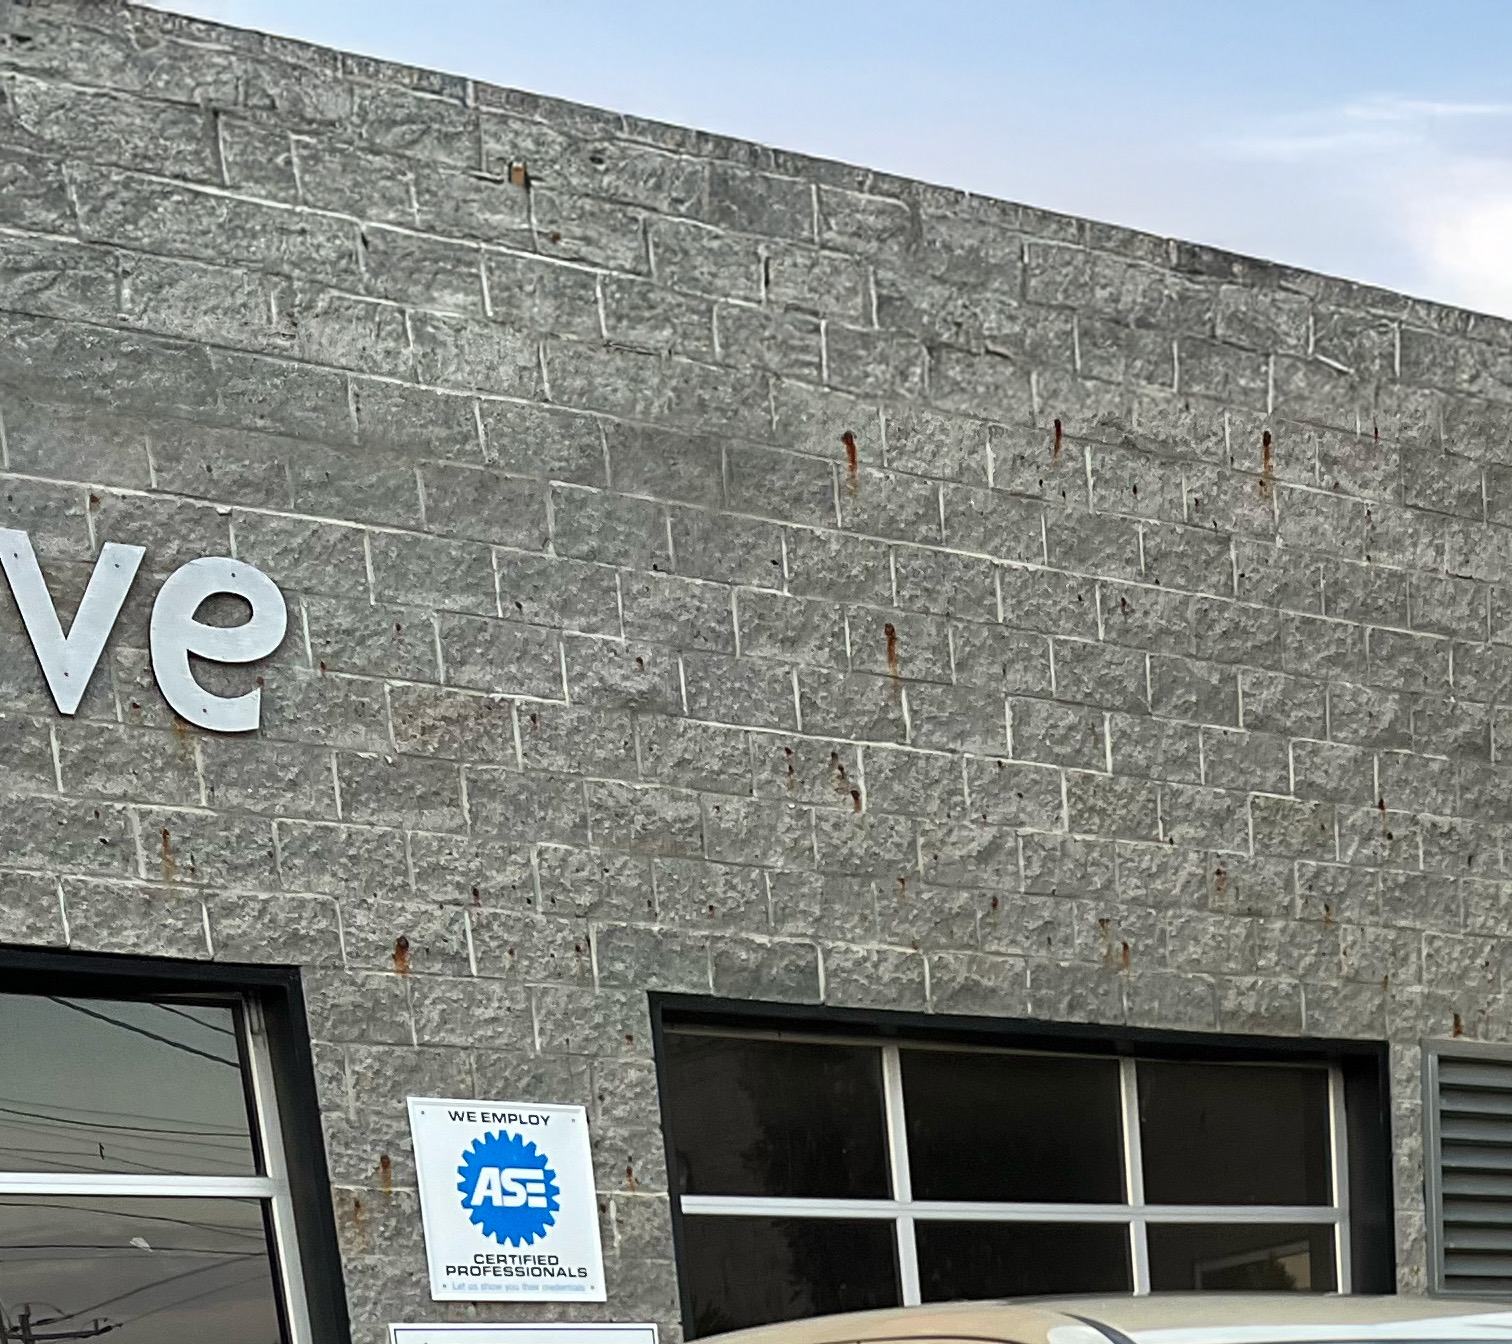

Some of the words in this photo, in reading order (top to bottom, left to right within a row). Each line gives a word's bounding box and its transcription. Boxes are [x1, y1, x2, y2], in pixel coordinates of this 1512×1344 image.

[0, 527, 288, 732] ve
[448, 1110, 477, 1122] WE
[481, 1112, 550, 1126] EMPLOY
[470, 1166, 548, 1208] ASE
[473, 1253, 559, 1265] CERTIFIED
[445, 1265, 588, 1278] PROFESSIONALS
